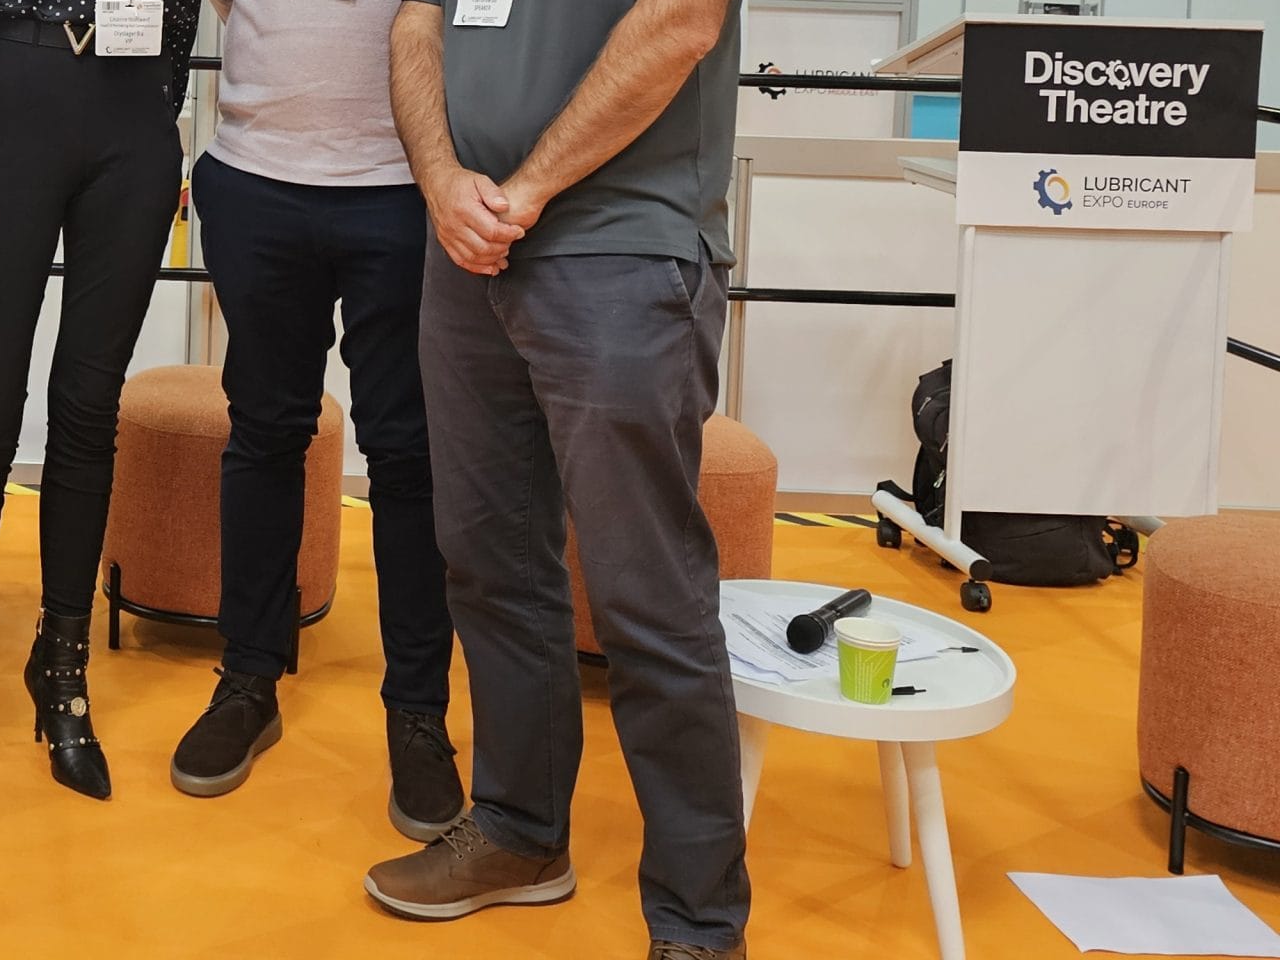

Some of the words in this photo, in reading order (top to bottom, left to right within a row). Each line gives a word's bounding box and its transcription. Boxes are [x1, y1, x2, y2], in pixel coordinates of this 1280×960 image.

[1024, 50, 1210, 95] Discovery
[1038, 89, 1188, 126] Theatre
[1083, 176, 1192, 194] LUBRICANT
[1082, 195, 1124, 208] EXPO
[1127, 199, 1169, 209] EUROPE
